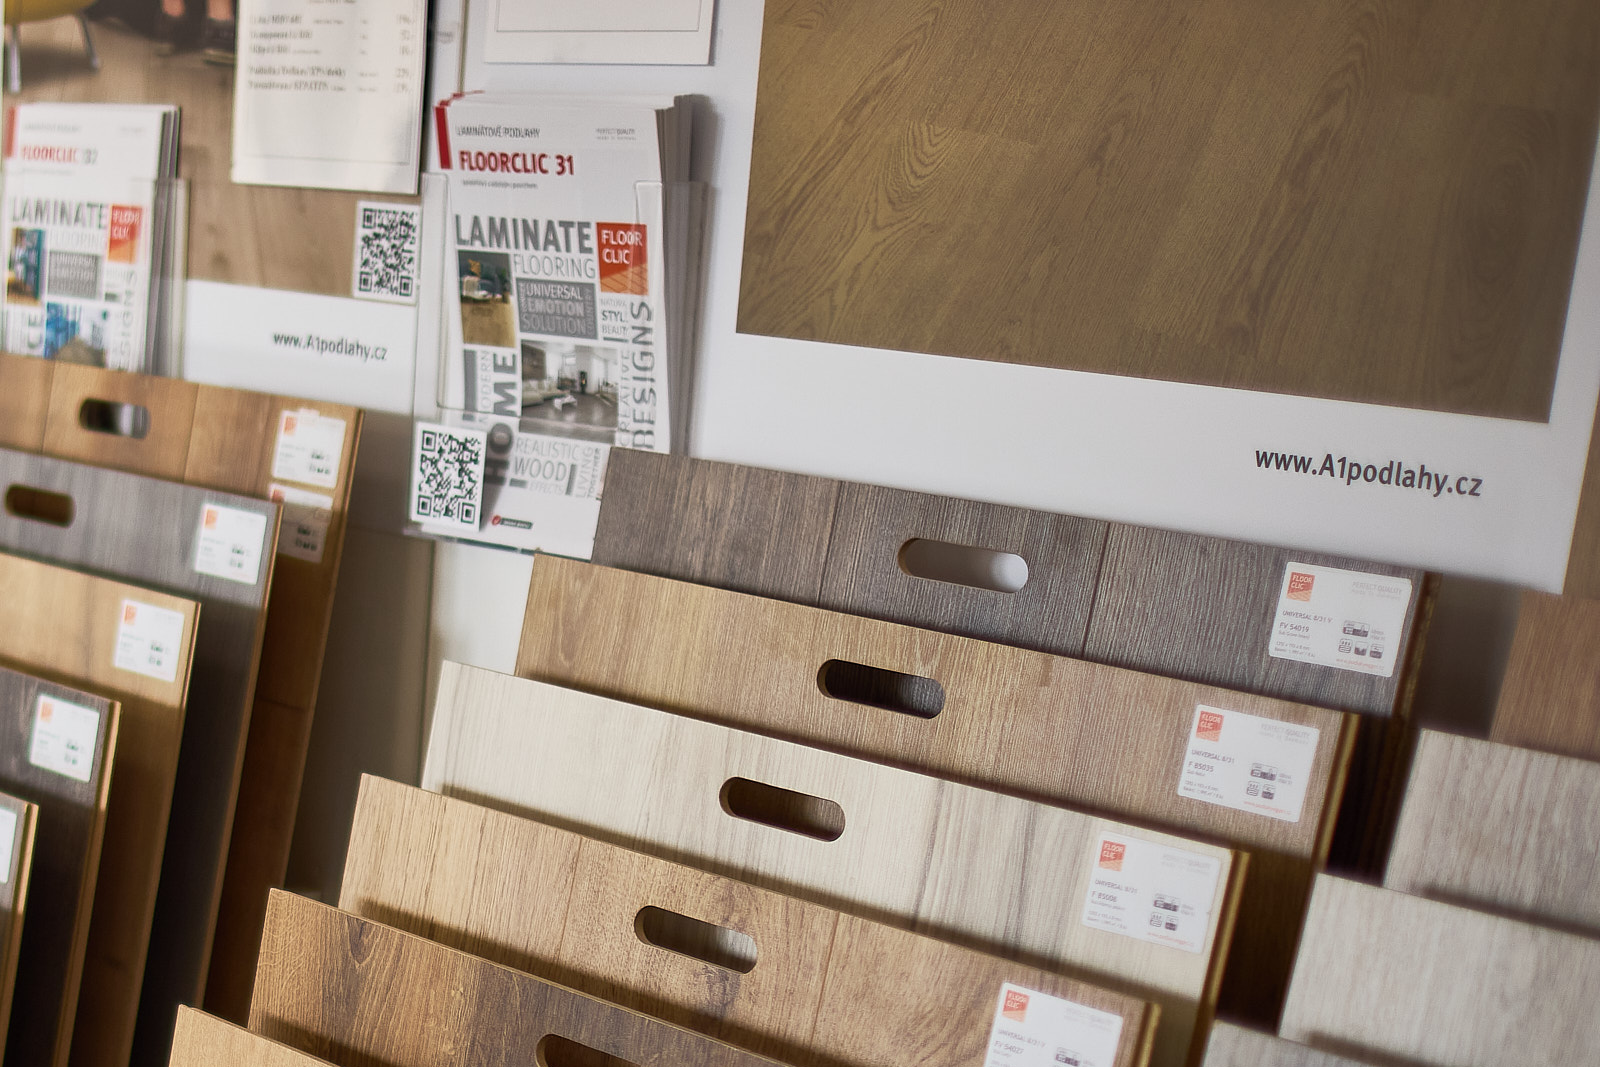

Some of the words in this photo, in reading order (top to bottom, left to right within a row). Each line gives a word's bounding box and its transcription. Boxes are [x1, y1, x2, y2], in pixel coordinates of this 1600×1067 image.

[21, 146, 79, 163] FLOORCLIC
[459, 151, 549, 174] FLOORCLIC
[555, 155, 575, 175] 31
[11, 198, 106, 229] LAMINATE
[455, 214, 594, 254] LAMINATE
[602, 229, 643, 247] FLOOR
[513, 253, 596, 279] FLOORING
[602, 248, 631, 265] CLIC
[526, 284, 584, 300] UNIVERSAL
[529, 300, 585, 317] EMOTION
[521, 315, 587, 335] SOLUTION
[273, 333, 388, 361] www.A1podlahy.cz
[631, 301, 656, 449] DESIGNS
[484, 353, 518, 485] HOME
[514, 437, 581, 461] REALISTIC
[513, 456, 567, 482] WOOD
[1255, 450, 1483, 498] www.A1podlahy.cz
[1291, 582, 1304, 590] CLIC
[1292, 575, 1312, 583] FLOOR
[1282, 610, 1312, 621] UNIVERSAL
[1191, 749, 1221, 761] UNIVERSAL
[1095, 879, 1123, 892] UNIVERSAL
